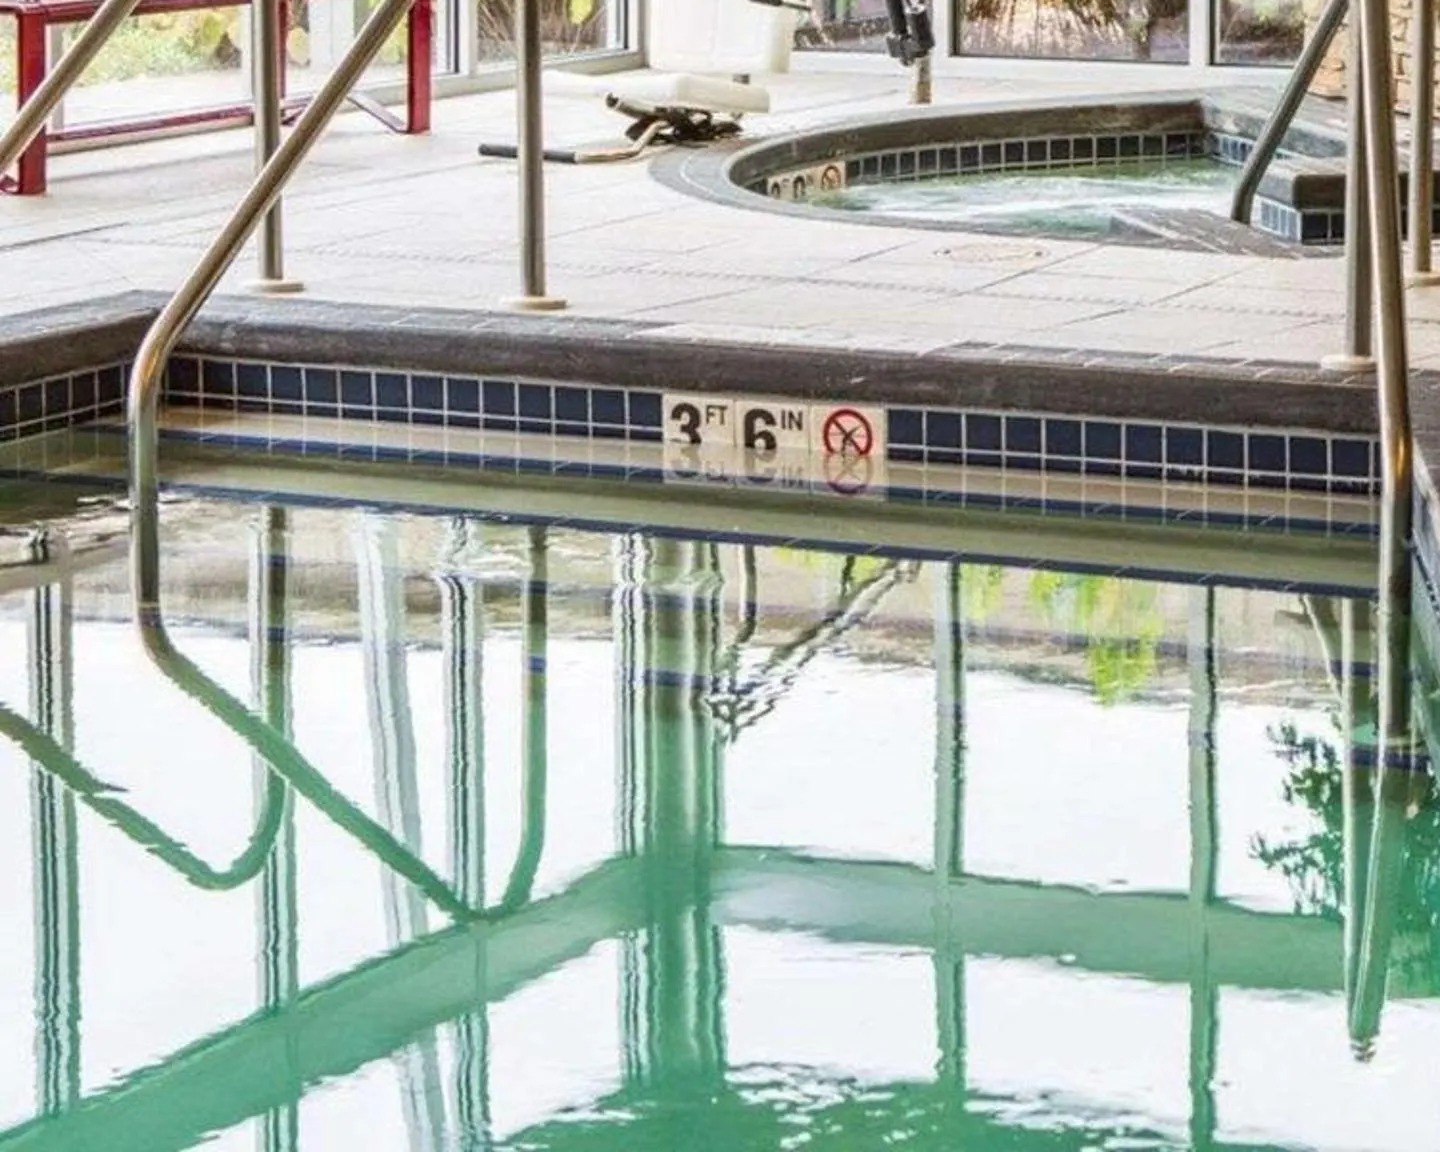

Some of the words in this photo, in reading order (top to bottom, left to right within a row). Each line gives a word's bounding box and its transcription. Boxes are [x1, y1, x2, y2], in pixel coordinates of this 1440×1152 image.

[670, 403, 702, 445] 3
[705, 404, 729, 426] FT
[744, 408, 777, 450] 6
[781, 409, 804, 431] IN
